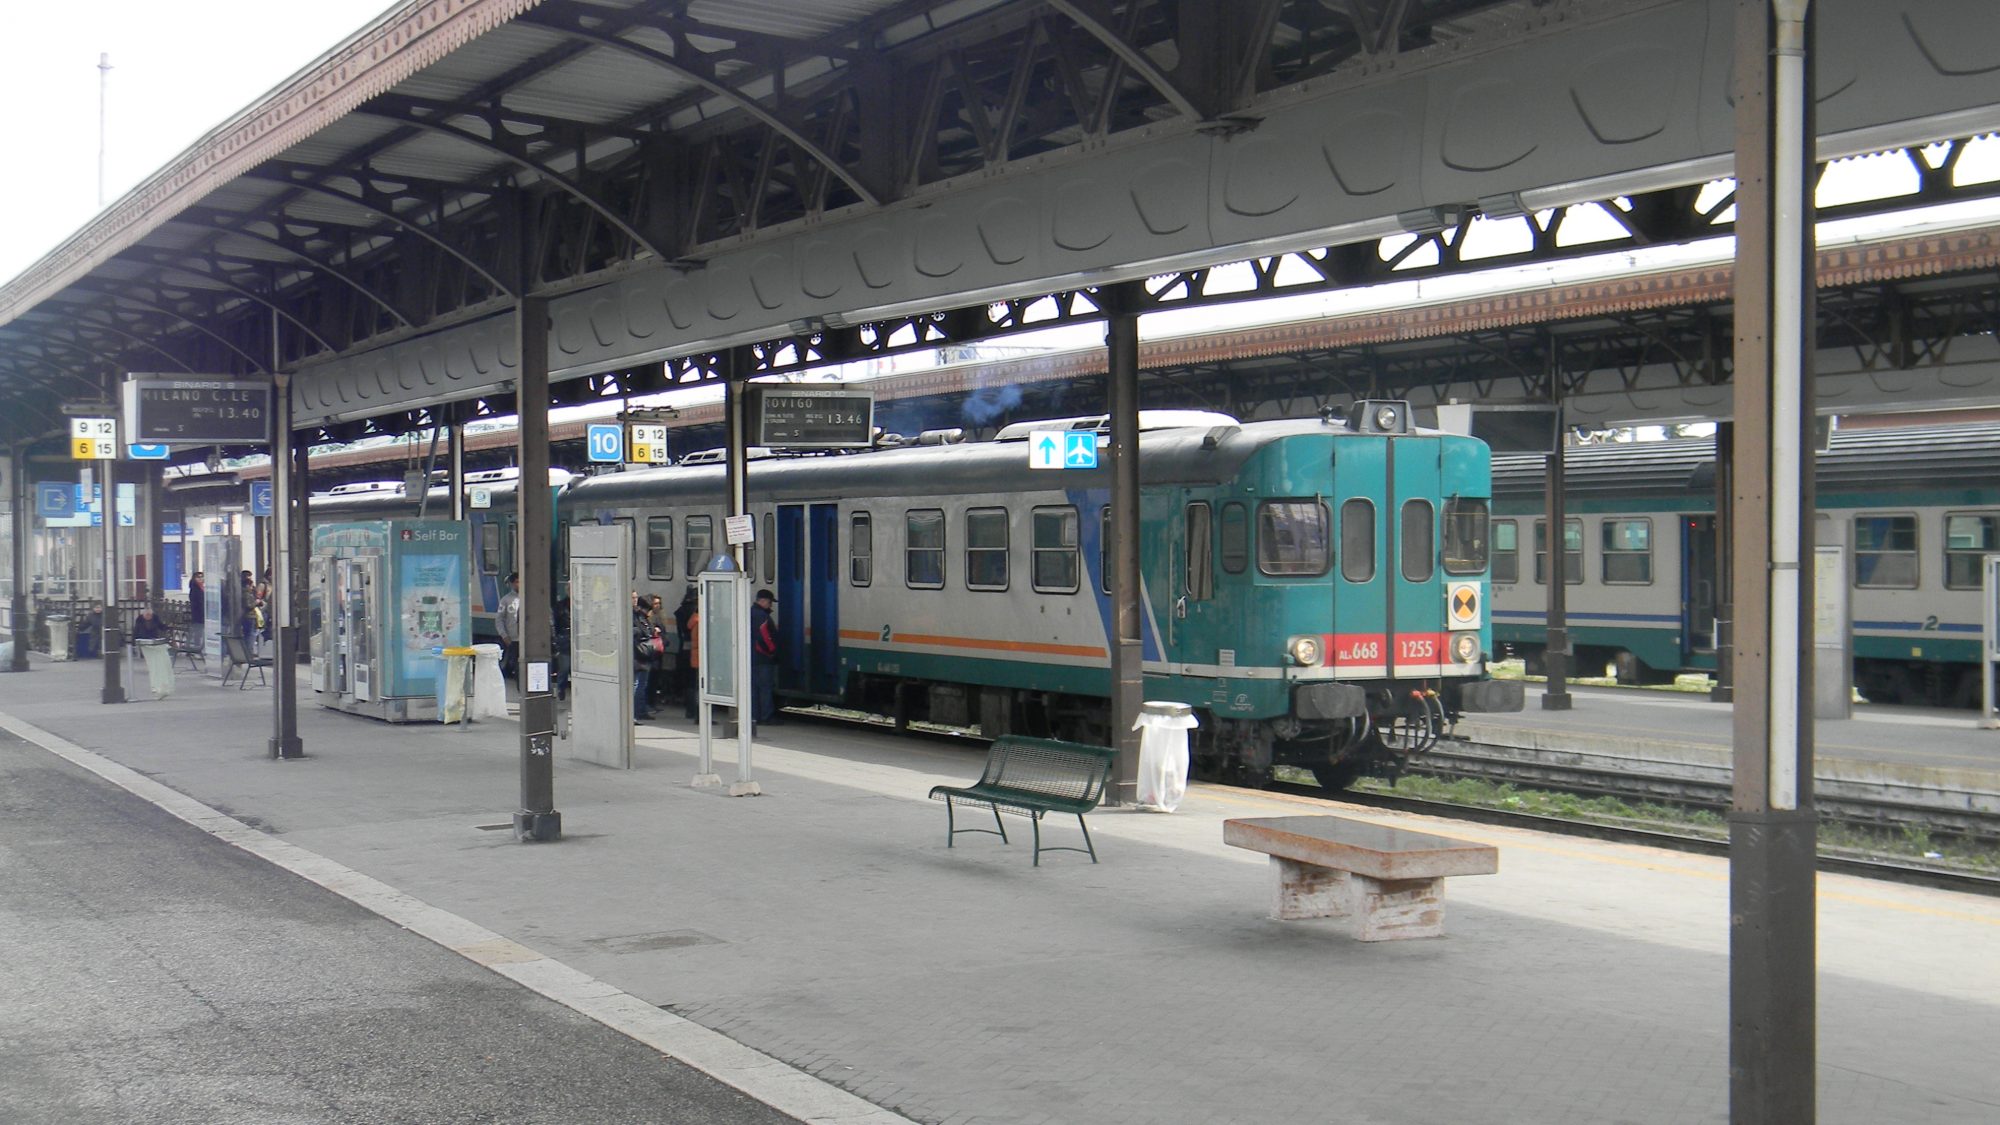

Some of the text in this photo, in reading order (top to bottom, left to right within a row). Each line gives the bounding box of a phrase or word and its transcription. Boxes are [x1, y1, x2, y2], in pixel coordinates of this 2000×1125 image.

[219, 408, 260, 418] 13.40
[828, 413, 862, 424] 13.46
[80, 422, 112, 433] 9 12
[638, 429, 664, 440] 9 12
[80, 443, 112, 454] 6 15
[592, 432, 618, 454] 10
[638, 448, 664, 459] 6 15
[414, 530, 459, 541] Self Bar
[1924, 615, 1939, 631] 2
[881, 624, 891, 642] 2
[1402, 640, 1433, 658] 1255
